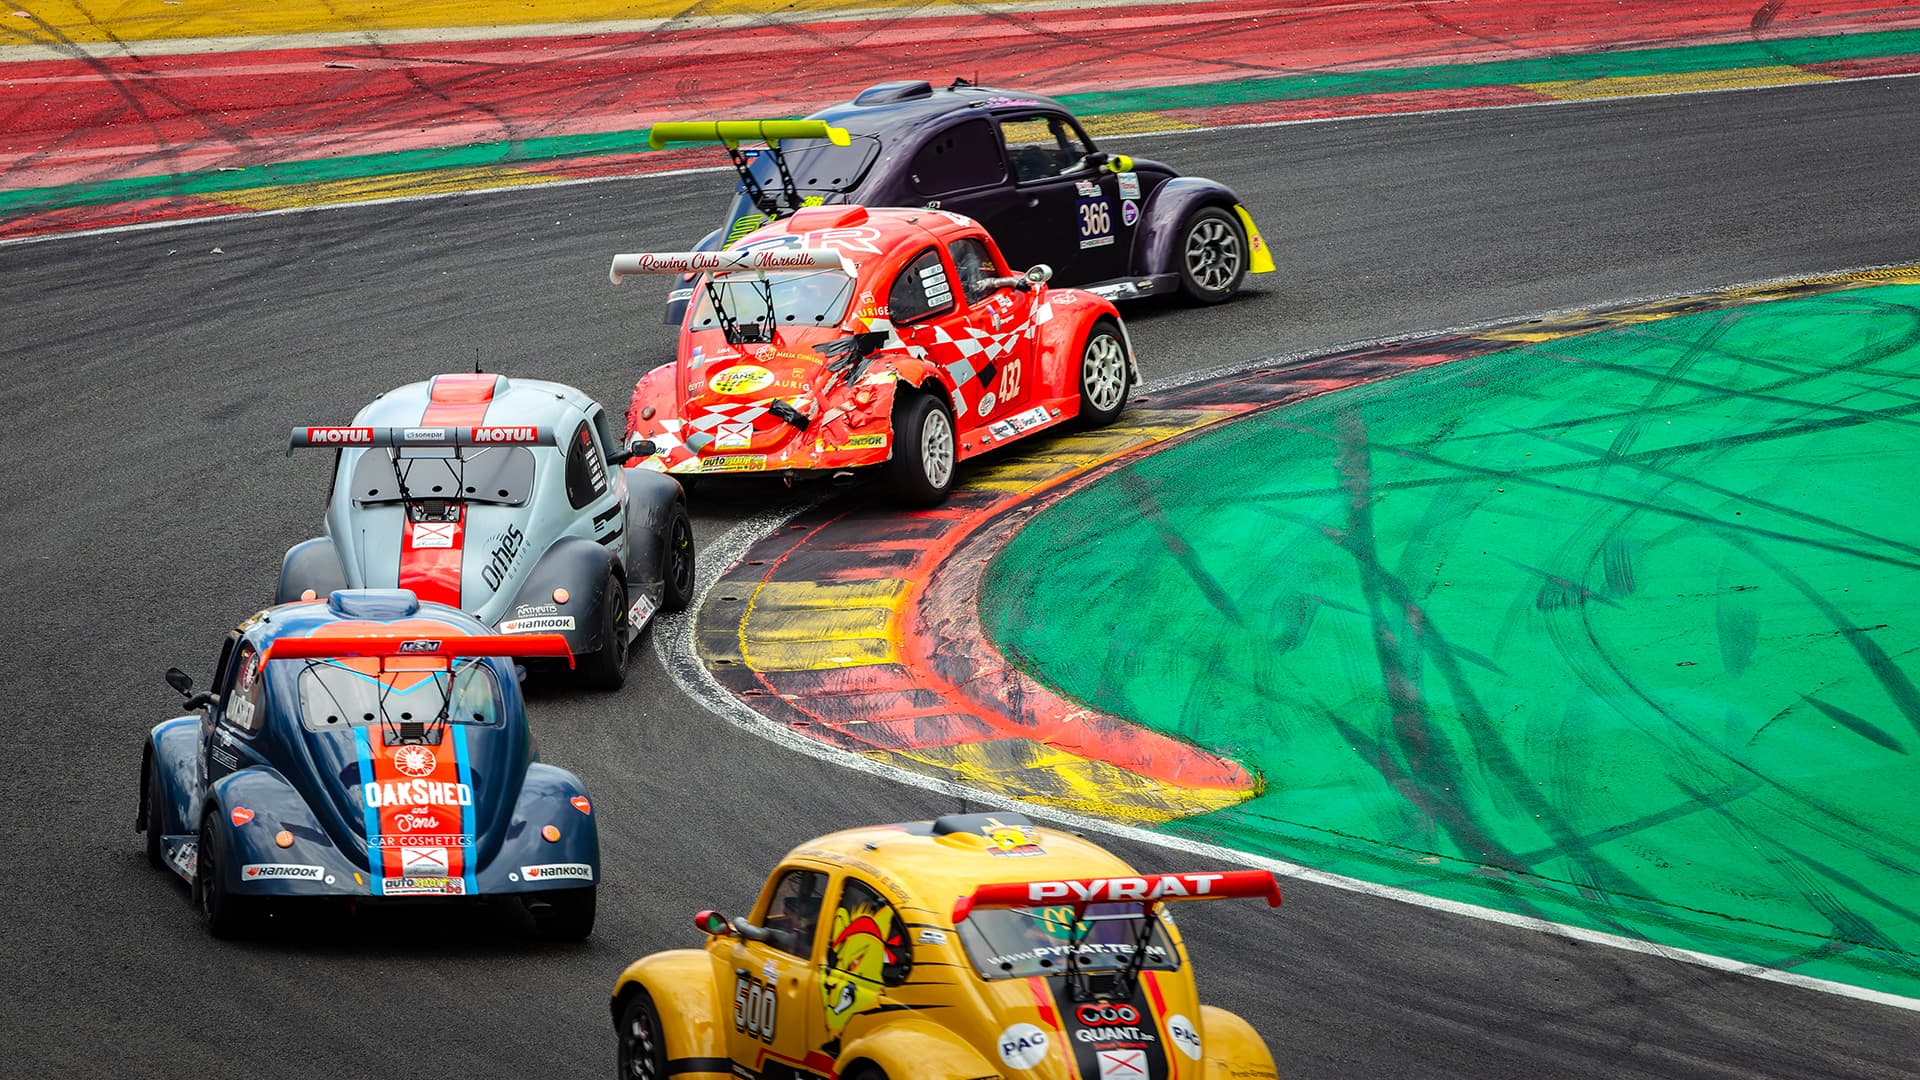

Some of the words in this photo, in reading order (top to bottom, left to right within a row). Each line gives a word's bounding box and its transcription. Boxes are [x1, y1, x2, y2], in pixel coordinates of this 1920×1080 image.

[1079, 201, 1111, 237] 366
[638, 253, 688, 272] Rowing
[691, 252, 720, 269] Club
[753, 251, 816, 268] Marseille
[998, 358, 1022, 404] 432
[310, 428, 371, 443] MOTUL
[414, 431, 444, 440] sonepar
[474, 427, 536, 442] MOTUL
[411, 806, 429, 814] and
[394, 813, 440, 832] Sons
[370, 836, 394, 846] CAR
[400, 835, 473, 846] COSMETICS
[1028, 874, 1223, 901] PYRAT
[734, 973, 778, 1044] 500
[1002, 1032, 1045, 1056] PAG
[1172, 1025, 1201, 1047] PAG
